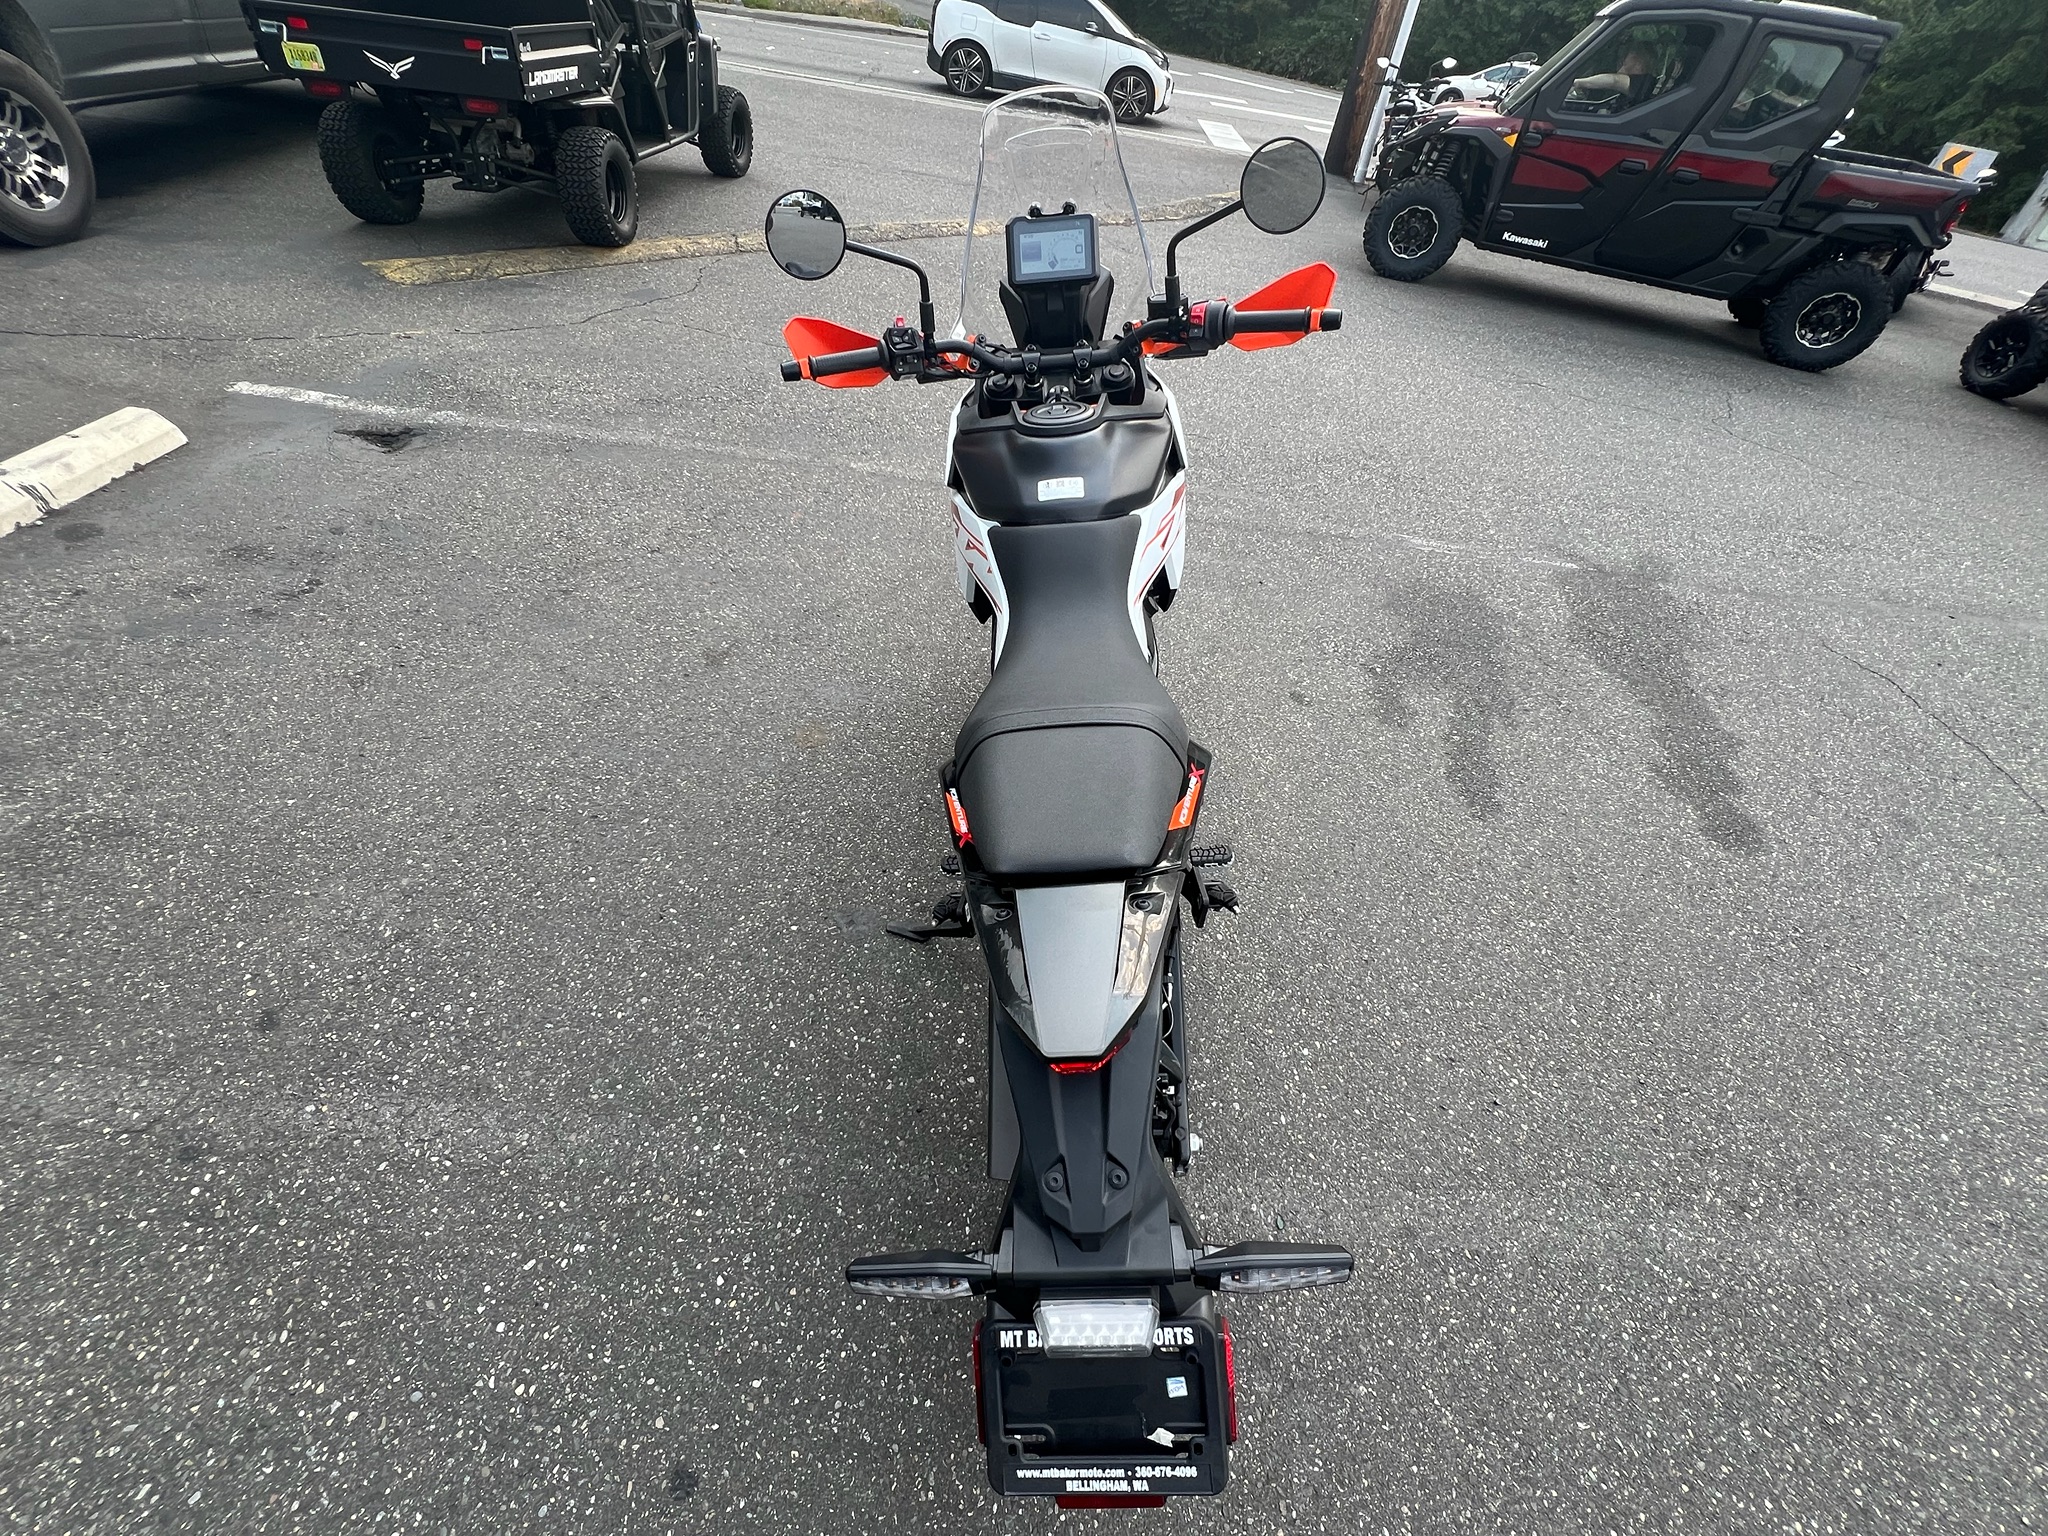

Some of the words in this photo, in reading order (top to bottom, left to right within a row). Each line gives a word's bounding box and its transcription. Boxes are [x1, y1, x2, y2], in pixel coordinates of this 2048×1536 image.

[528, 65, 578, 86] LANDMASTER
[1502, 231, 1549, 249] Kawasaki
[1000, 1330, 1023, 1348] MT
[1152, 1326, 1194, 1346] ORTS
[1016, 1466, 1126, 1478] www.mtbakermoto.com
[1134, 1465, 1198, 1478] 360-676-4096
[1065, 1479, 1131, 1492] BELLINGHAM,
[1132, 1479, 1150, 1492] WA
